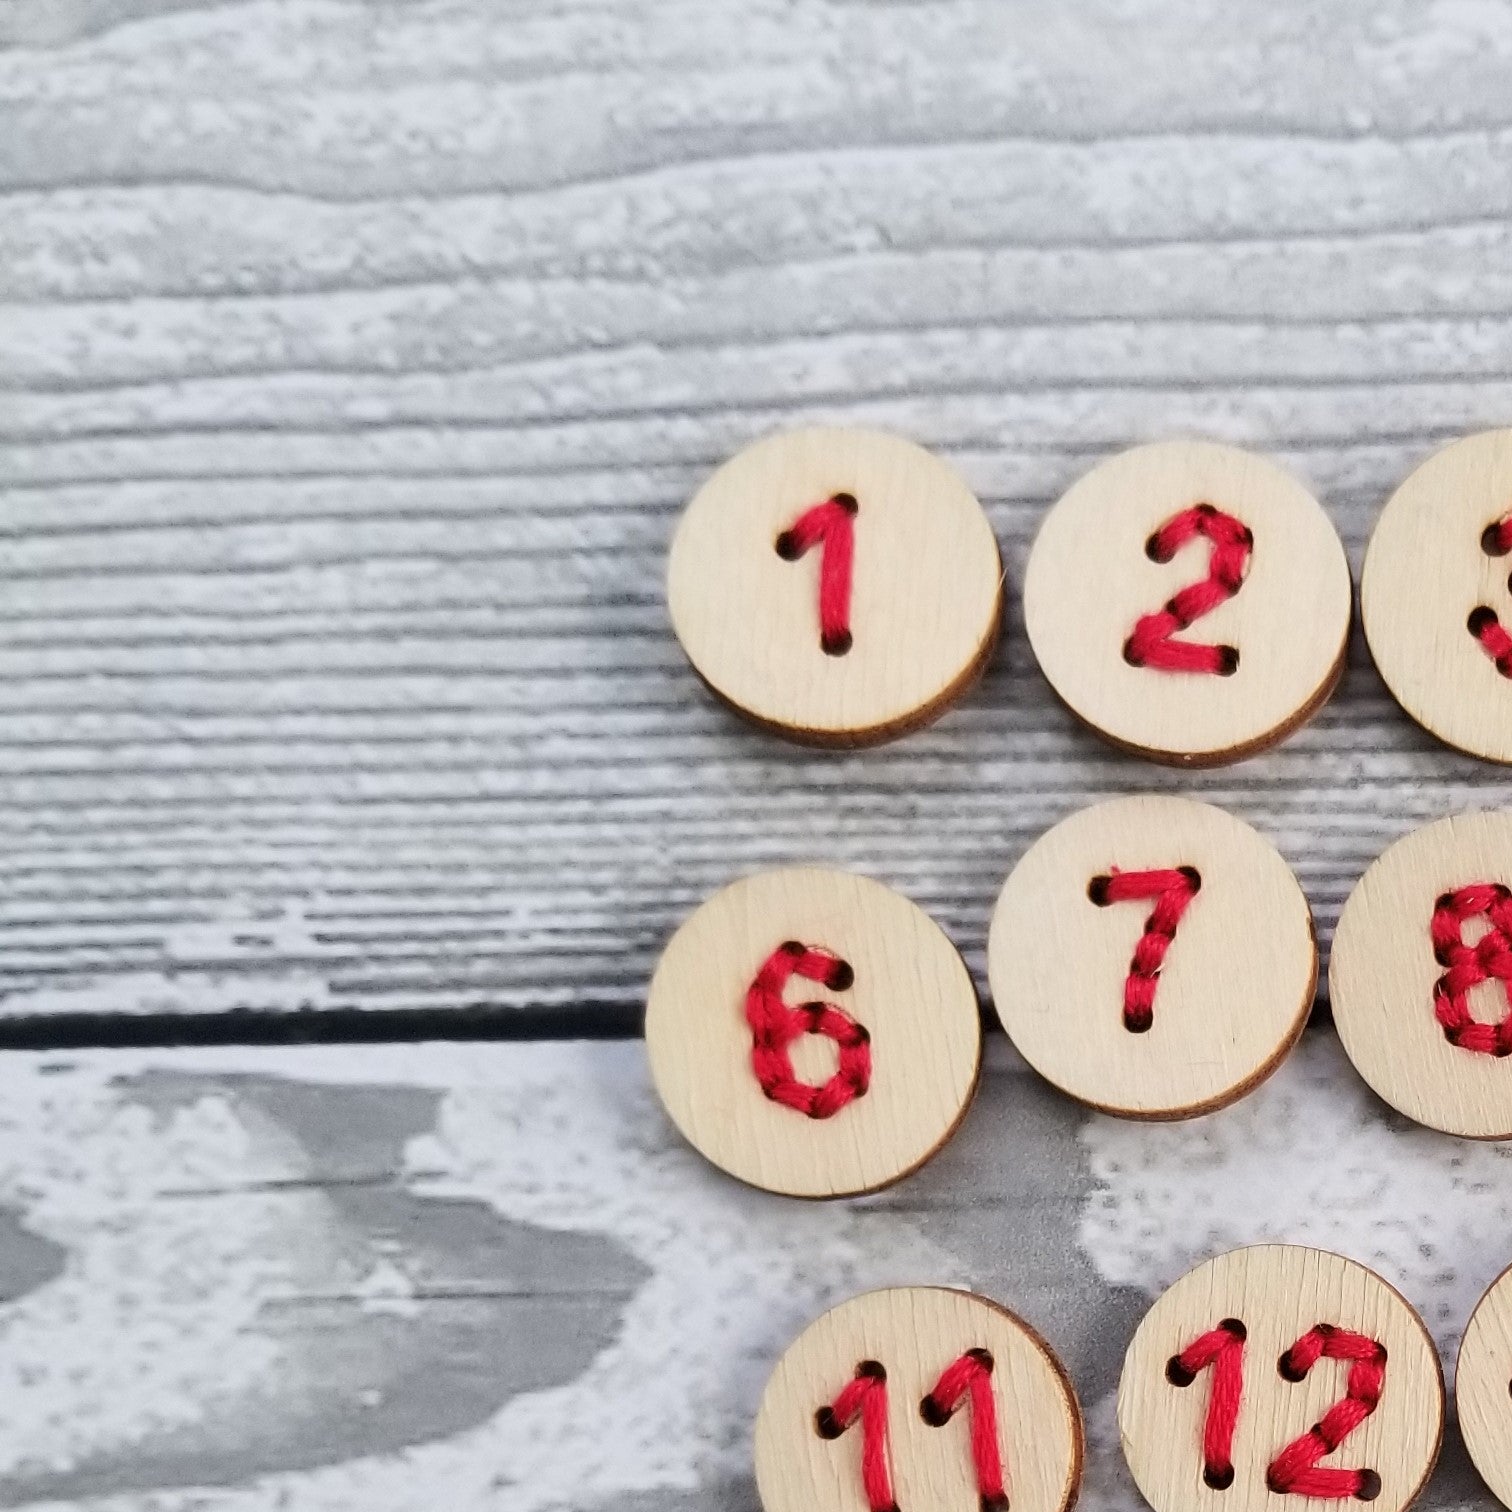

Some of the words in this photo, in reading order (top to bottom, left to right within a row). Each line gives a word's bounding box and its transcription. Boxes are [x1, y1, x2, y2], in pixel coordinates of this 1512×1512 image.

[777, 494, 858, 655] 1
[1124, 506, 1253, 675] 2
[740, 942, 871, 1119] 6
[1089, 867, 1201, 1033] 7
[1166, 1319, 1387, 1503] 12
